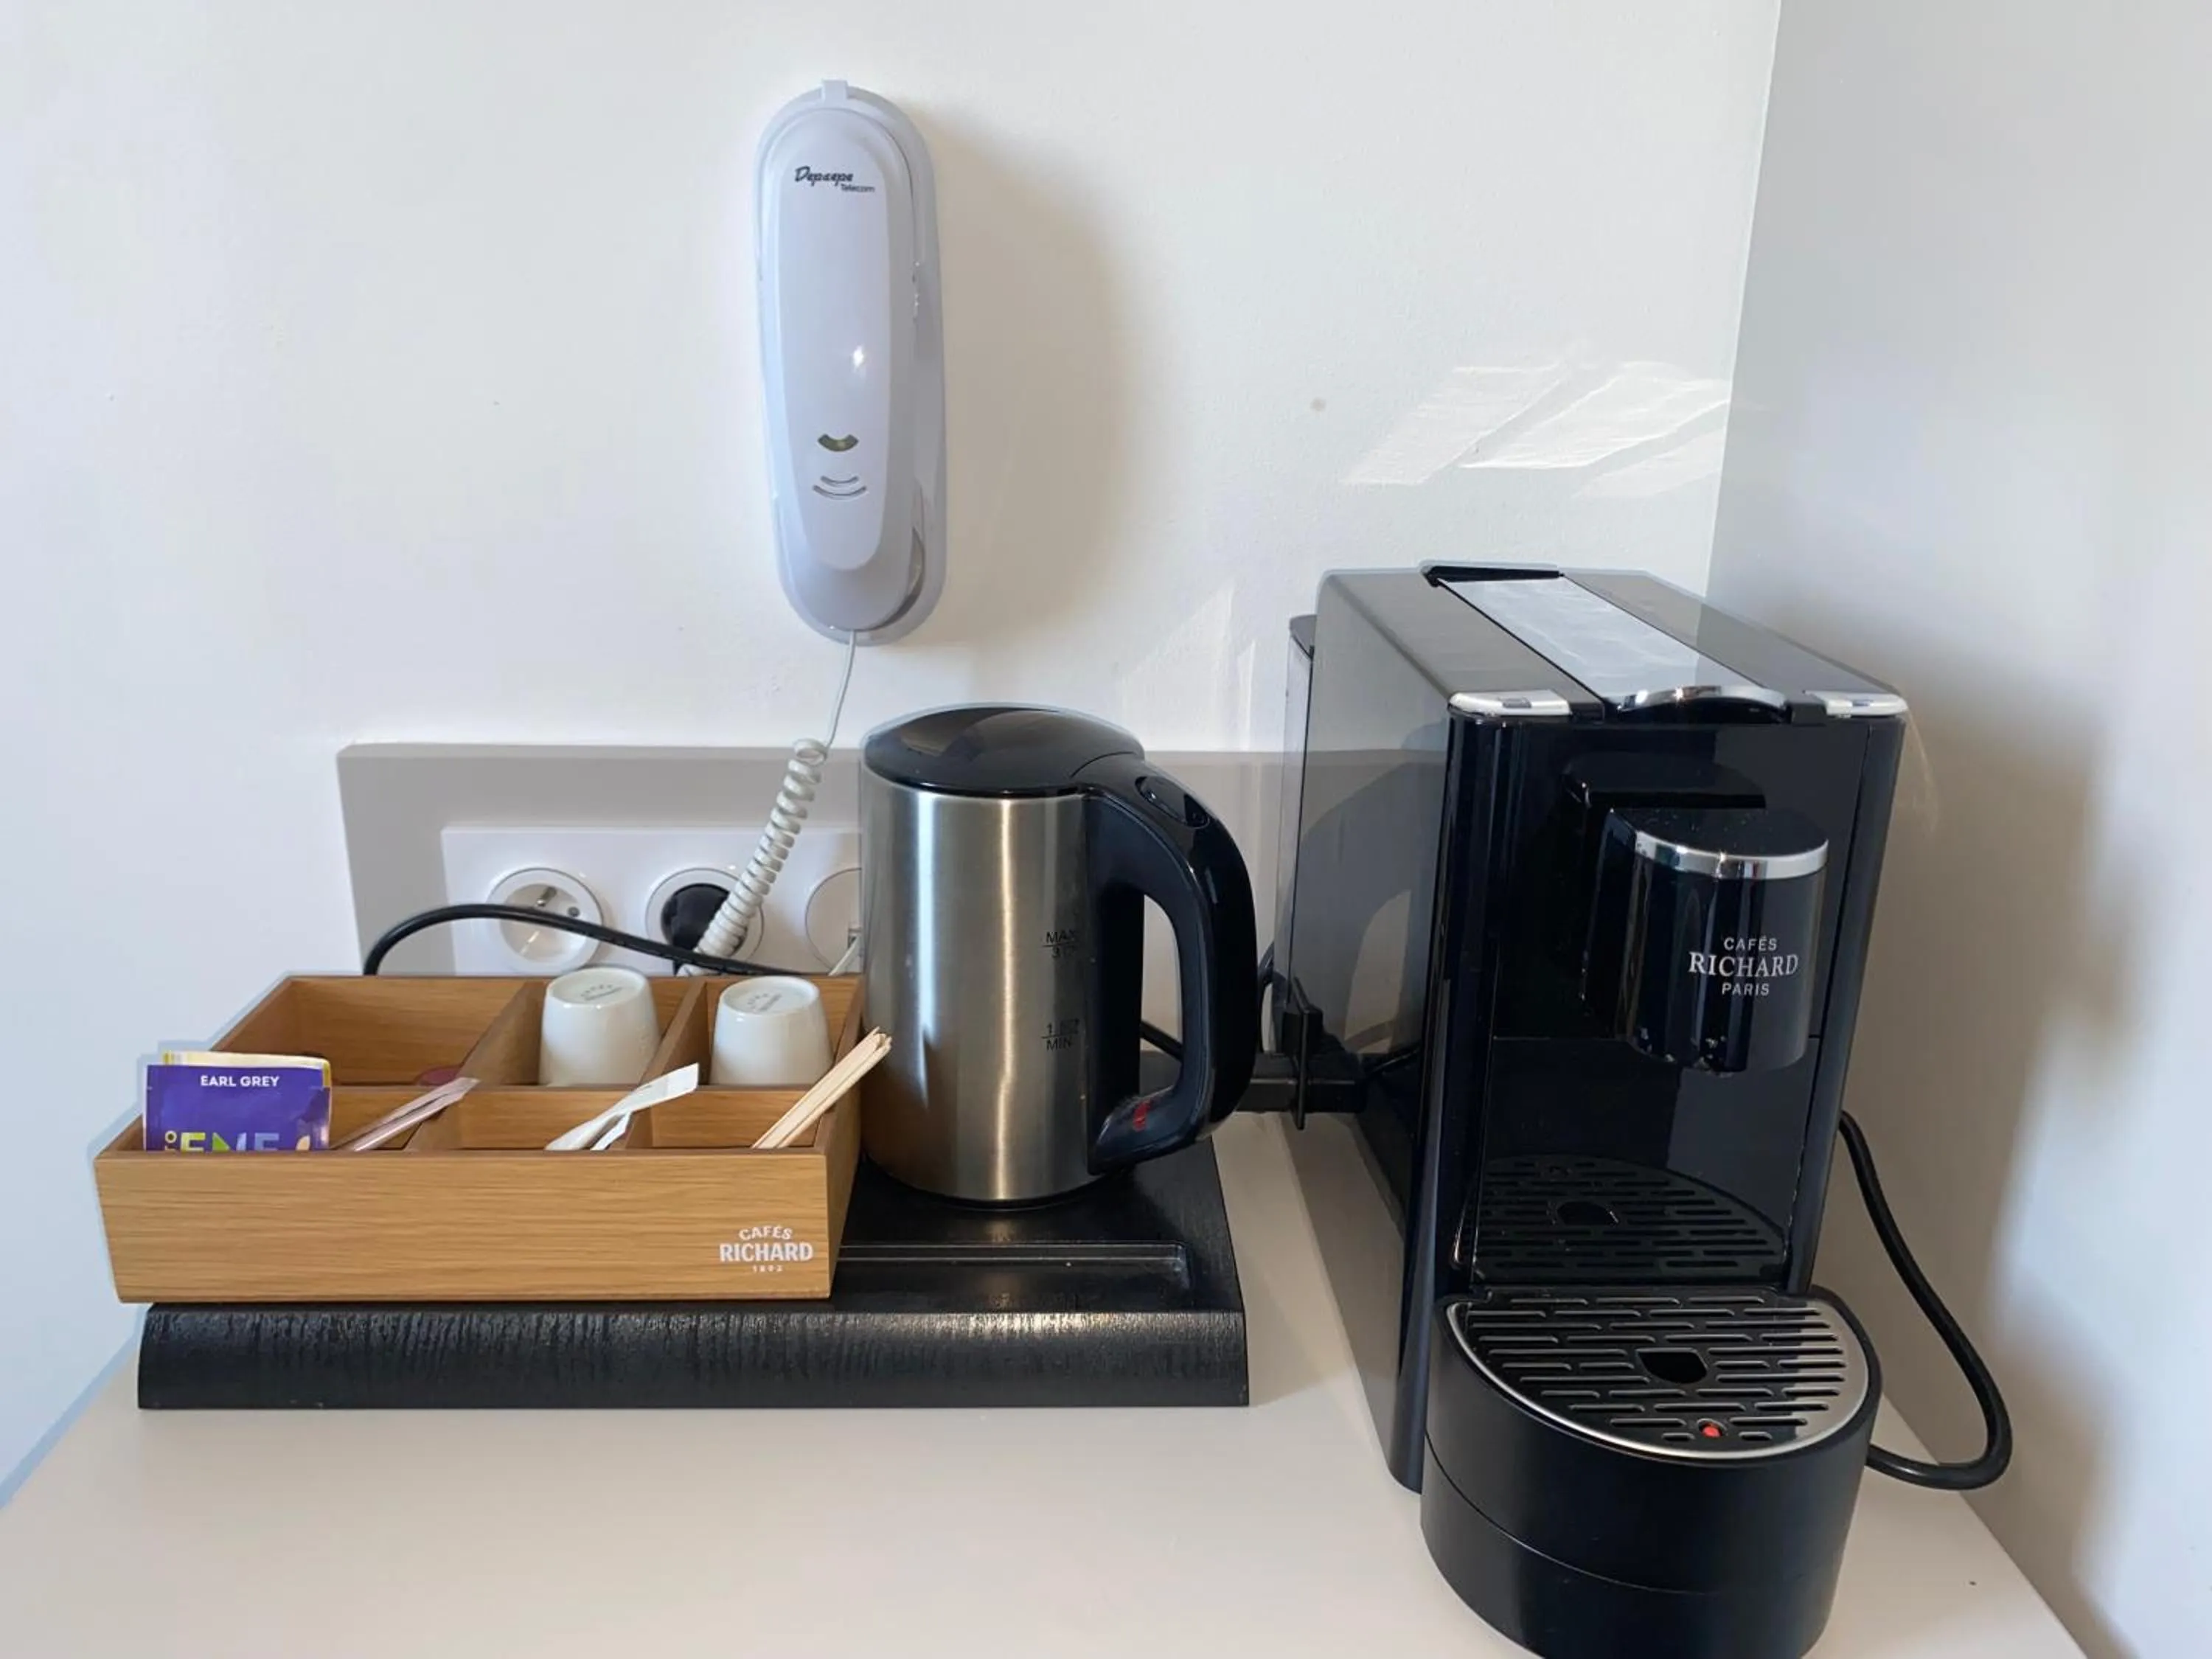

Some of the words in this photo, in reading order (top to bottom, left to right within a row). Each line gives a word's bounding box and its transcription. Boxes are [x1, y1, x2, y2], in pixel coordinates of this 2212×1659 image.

[1723, 936, 1778, 951] CAFÉS
[1688, 951, 1799, 978] RICHARD
[1722, 981, 1770, 996] PARIS
[200, 1075, 236, 1087] EARL
[240, 1075, 280, 1088] GREY
[738, 1224, 793, 1240] CAFÉS
[719, 1241, 813, 1262] RICHARD
